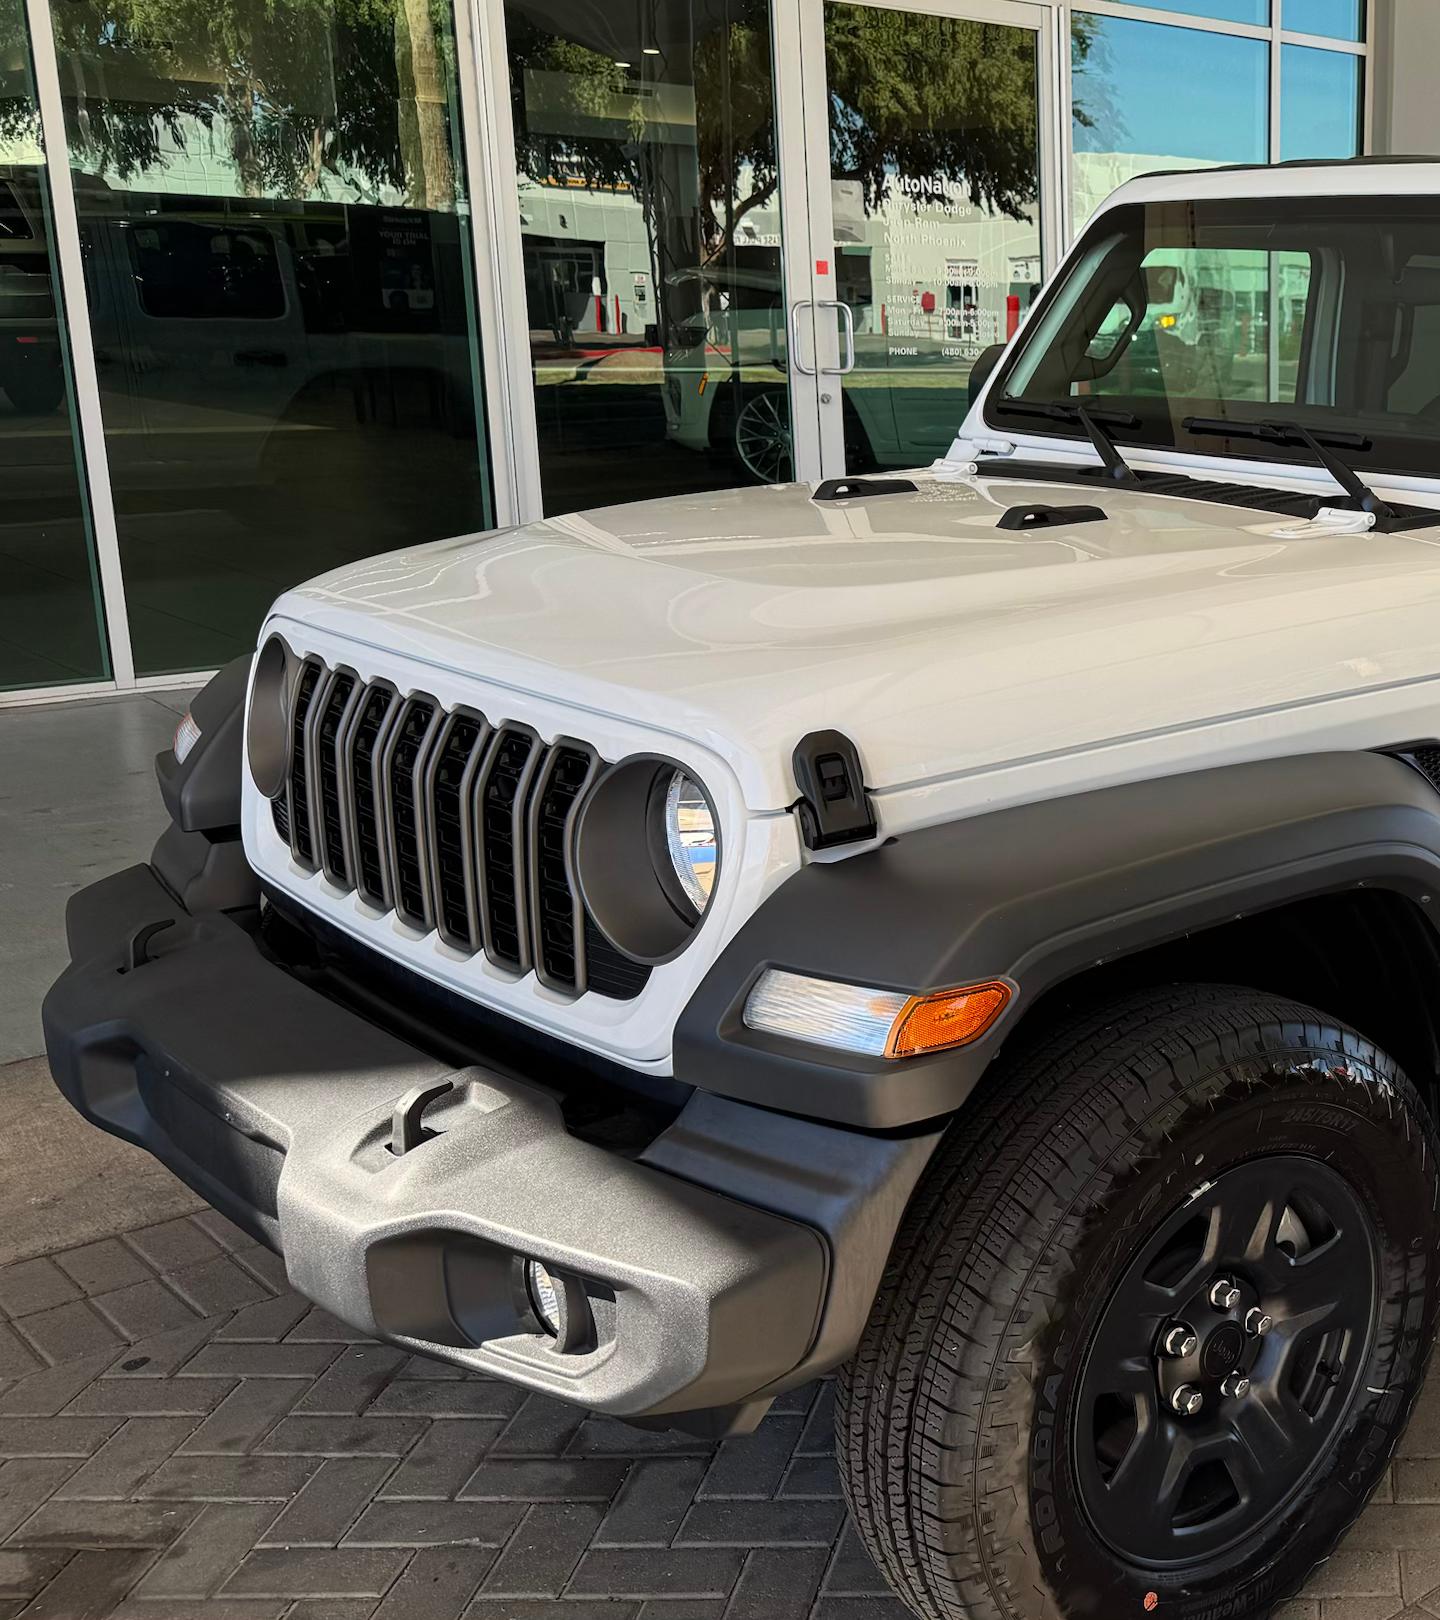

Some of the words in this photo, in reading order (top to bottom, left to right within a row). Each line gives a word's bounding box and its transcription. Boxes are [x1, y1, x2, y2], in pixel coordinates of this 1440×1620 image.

[882, 174, 972, 197] AutoNation
[883, 199, 935, 213] Chrysler
[936, 202, 972, 217] Dodge
[883, 217, 911, 229] Jeep
[915, 218, 940, 228] Ram
[884, 232, 918, 244] North
[922, 234, 967, 247] Phoenix
[888, 328, 919, 339] Sunday
[889, 347, 918, 356] PHONE
